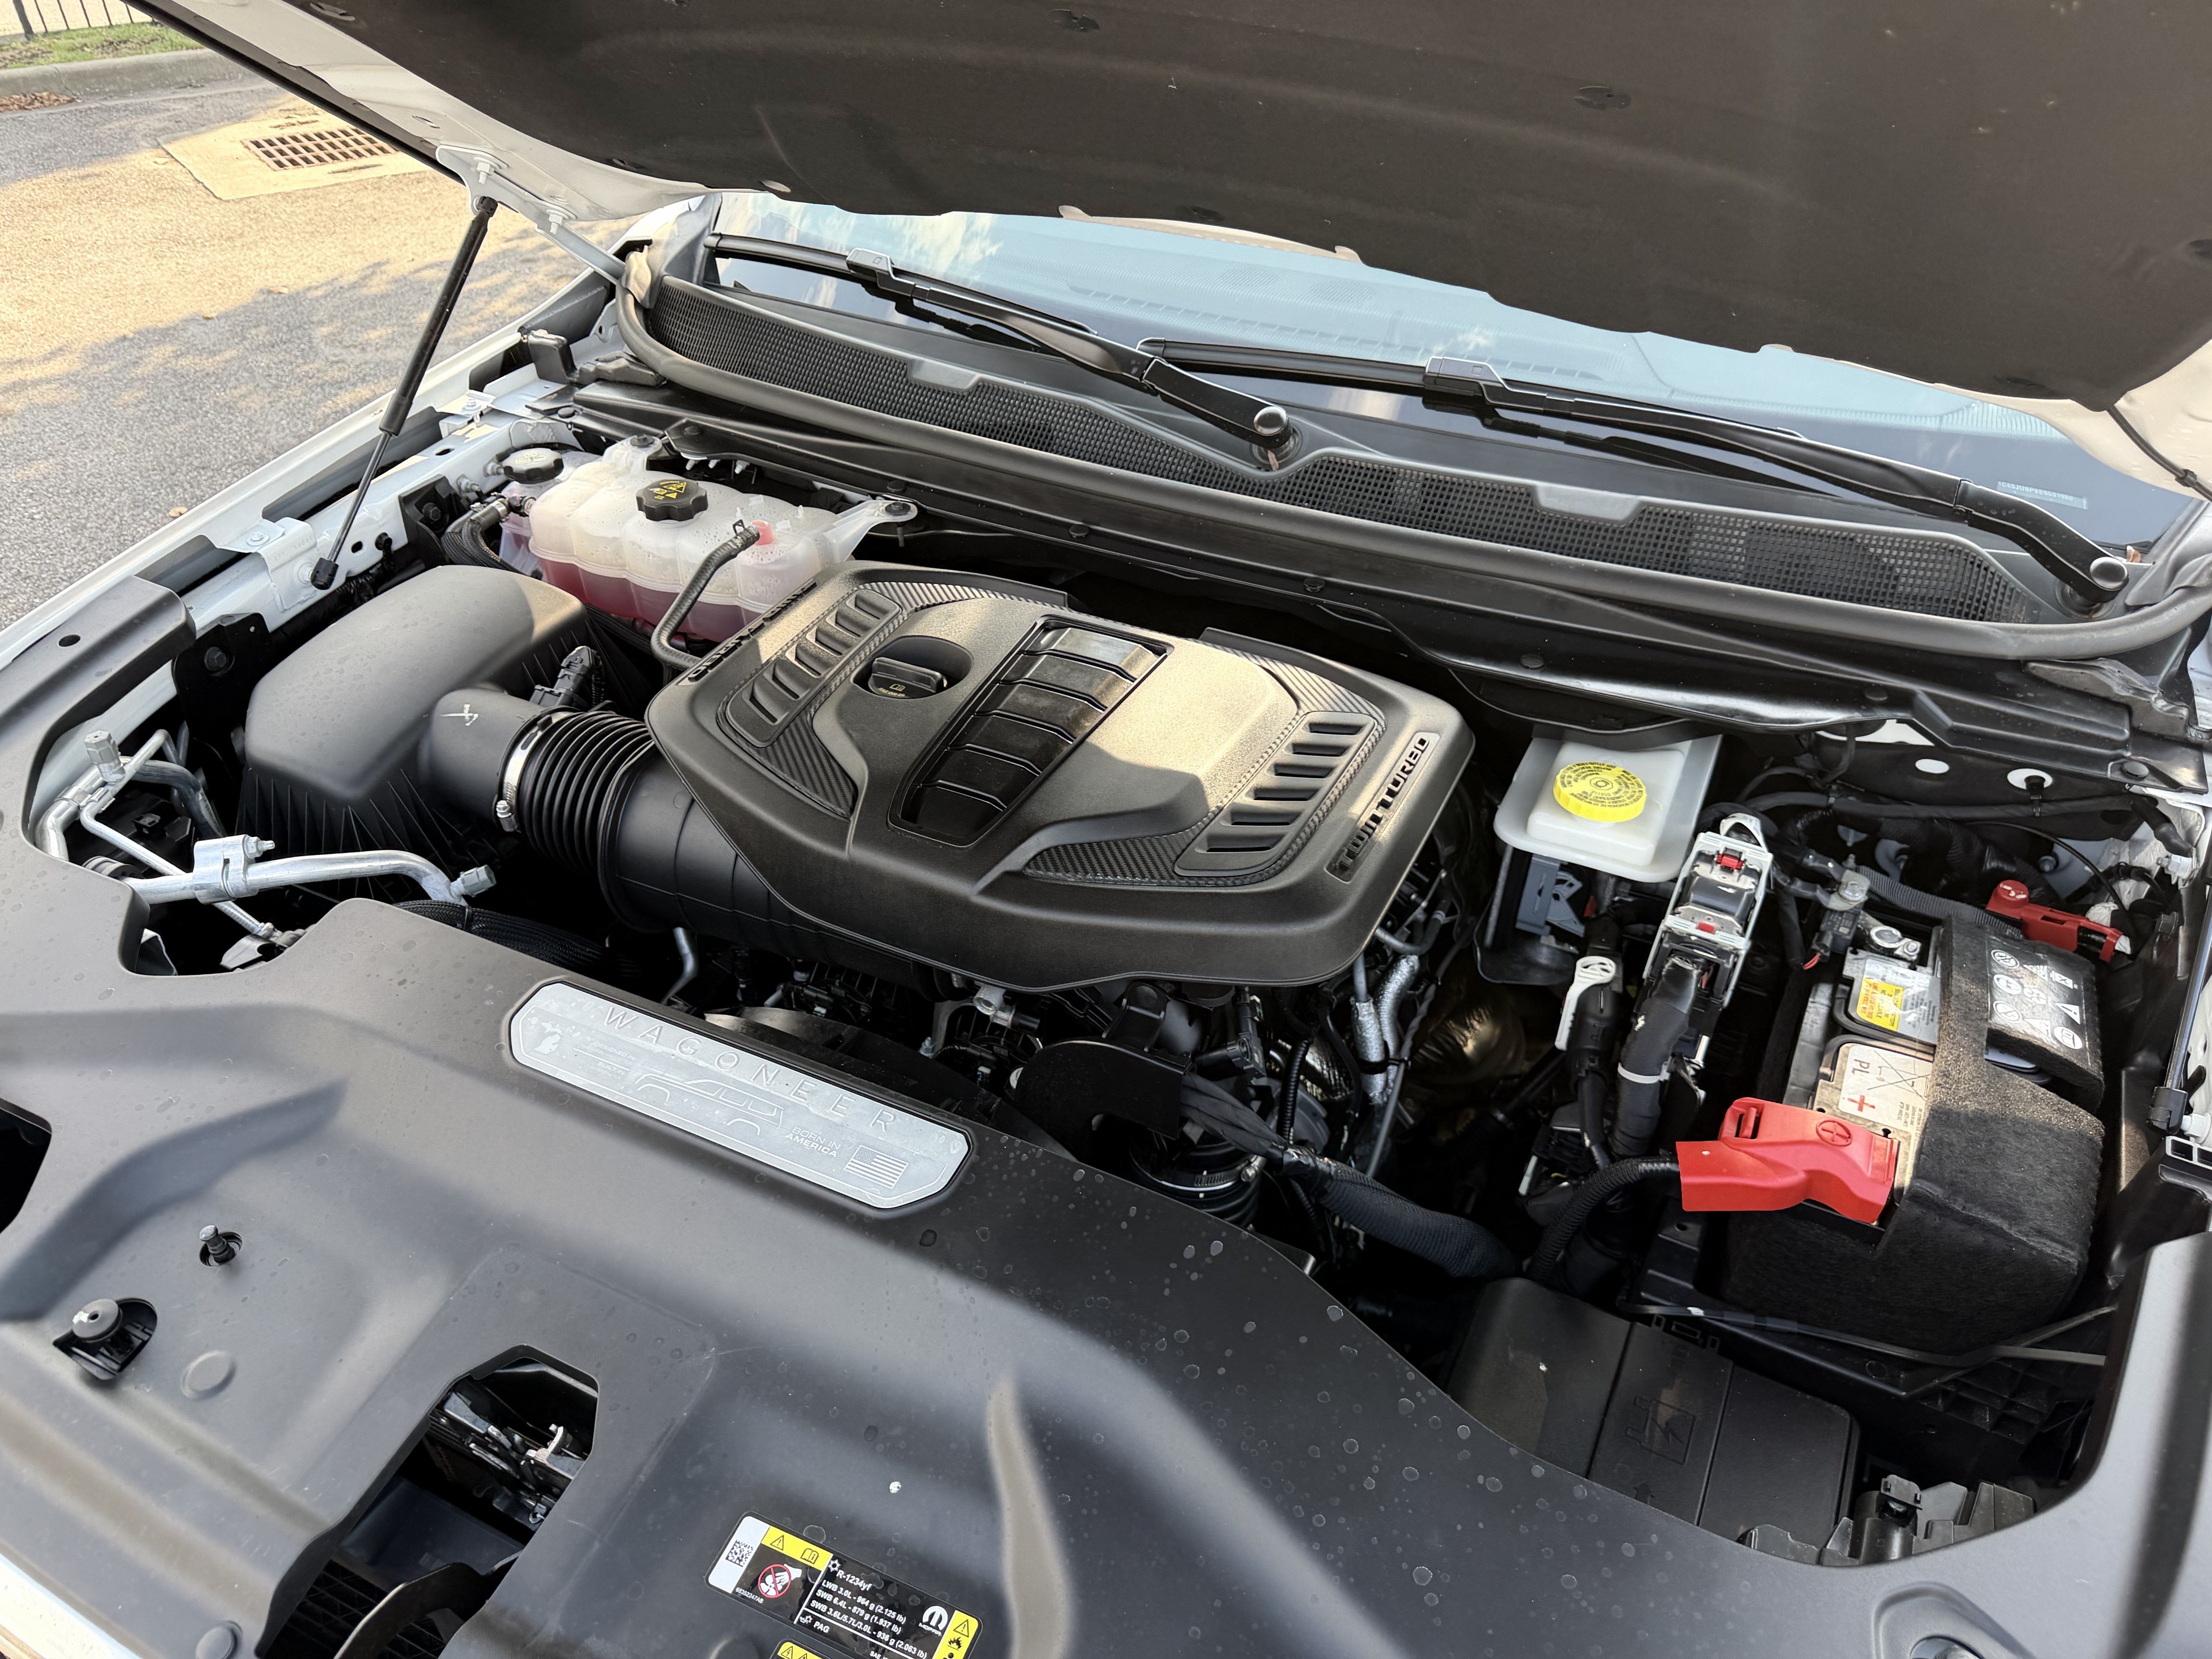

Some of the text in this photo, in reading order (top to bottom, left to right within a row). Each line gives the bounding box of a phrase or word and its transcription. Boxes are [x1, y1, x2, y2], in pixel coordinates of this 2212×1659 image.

[1336, 736, 1429, 869] TWIN TURBO
[603, 1006, 896, 1132] WAGONEER
[785, 1133, 837, 1157] AMERICA
[792, 1127, 841, 1150] BORN IN
[822, 1580, 838, 1591] LWB
[838, 1587, 852, 1599] 3.0L
[857, 1596, 869, 1606] 964
[875, 1604, 896, 1619] (2.125
[896, 1615, 906, 1625] lb)
[836, 1569, 872, 1591] R-1234yf
[810, 1600, 828, 1612] SWB
[827, 1608, 871, 1634] 3.6L/5.7L/3.0L
[876, 1631, 890, 1642] 936
[895, 1640, 917, 1654] (2.063
[916, 1650, 927, 1659] lb)
[814, 1621, 830, 1633] PAG
[816, 1589, 833, 1601] SWB
[833, 1597, 847, 1609] 6.4L
[852, 1606, 865, 1617] 879
[870, 1615, 892, 1628] (1.937
[891, 1625, 901, 1635] lb)
